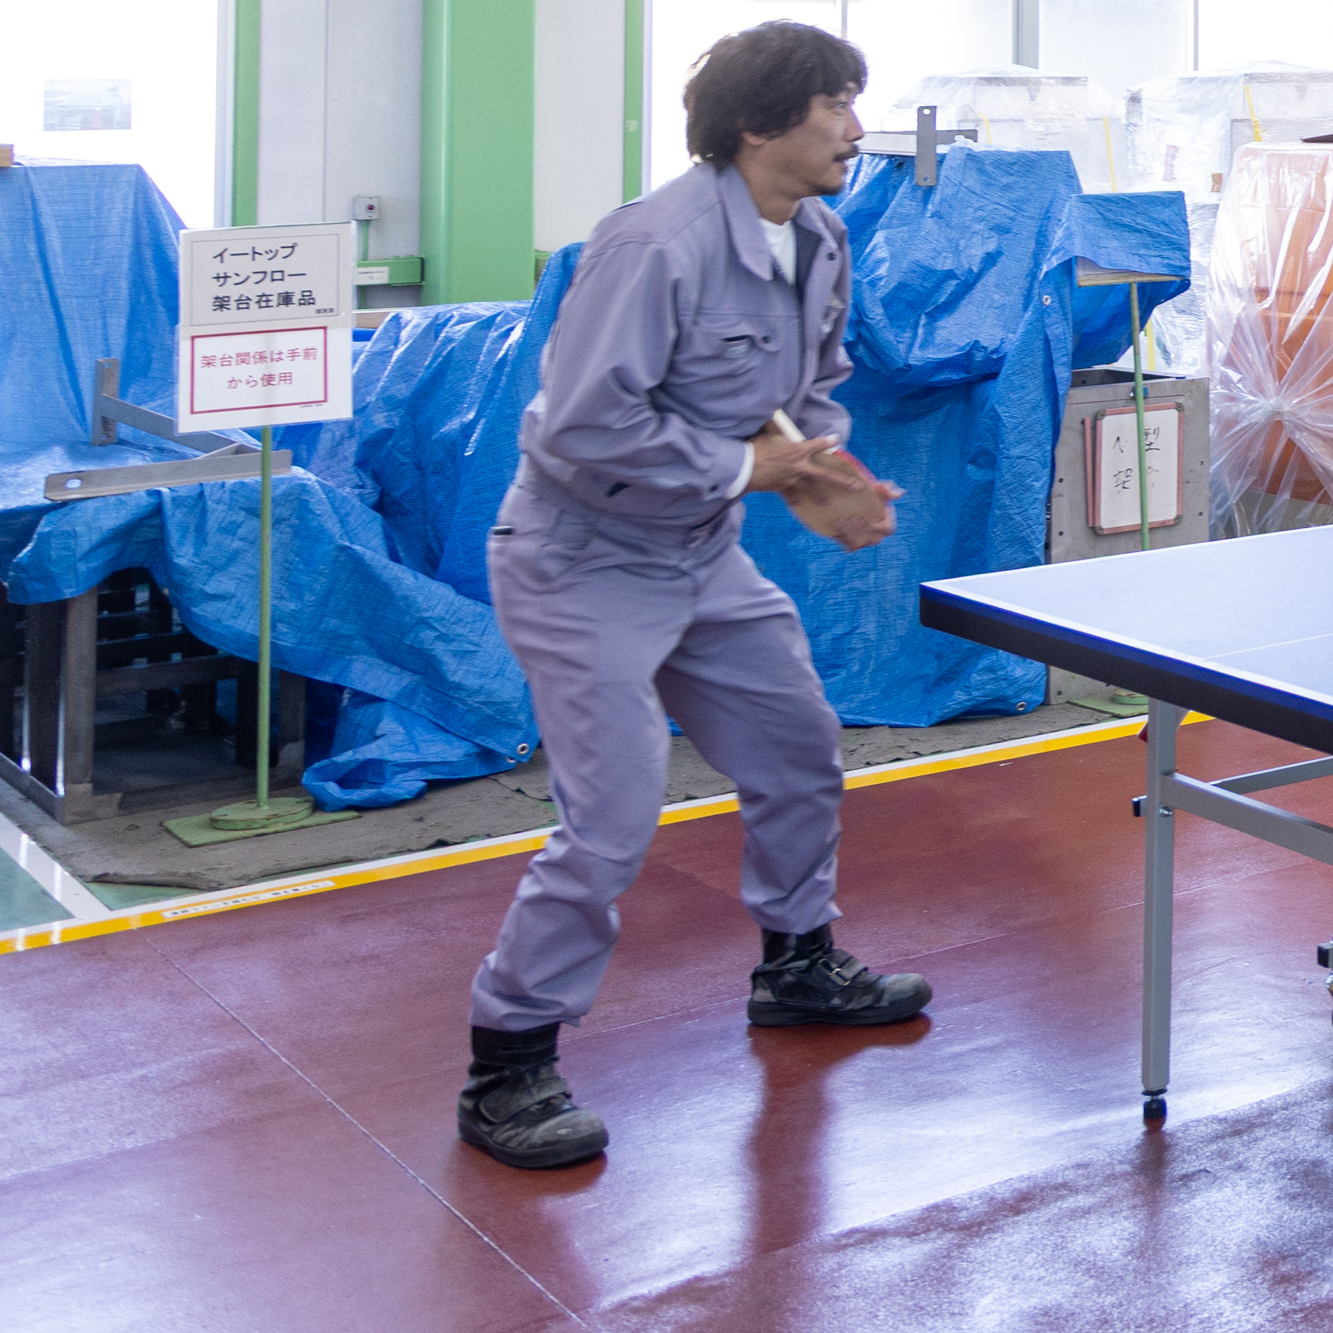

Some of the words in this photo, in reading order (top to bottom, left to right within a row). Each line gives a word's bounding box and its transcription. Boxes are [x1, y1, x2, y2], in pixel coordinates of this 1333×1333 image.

[212, 242, 298, 264] イートップ
[212, 270, 307, 288] サンフロー
[212, 290, 316, 312] 架台在庫品
[200, 347, 318, 369] 架台関係は手前
[227, 371, 294, 390] から使用
